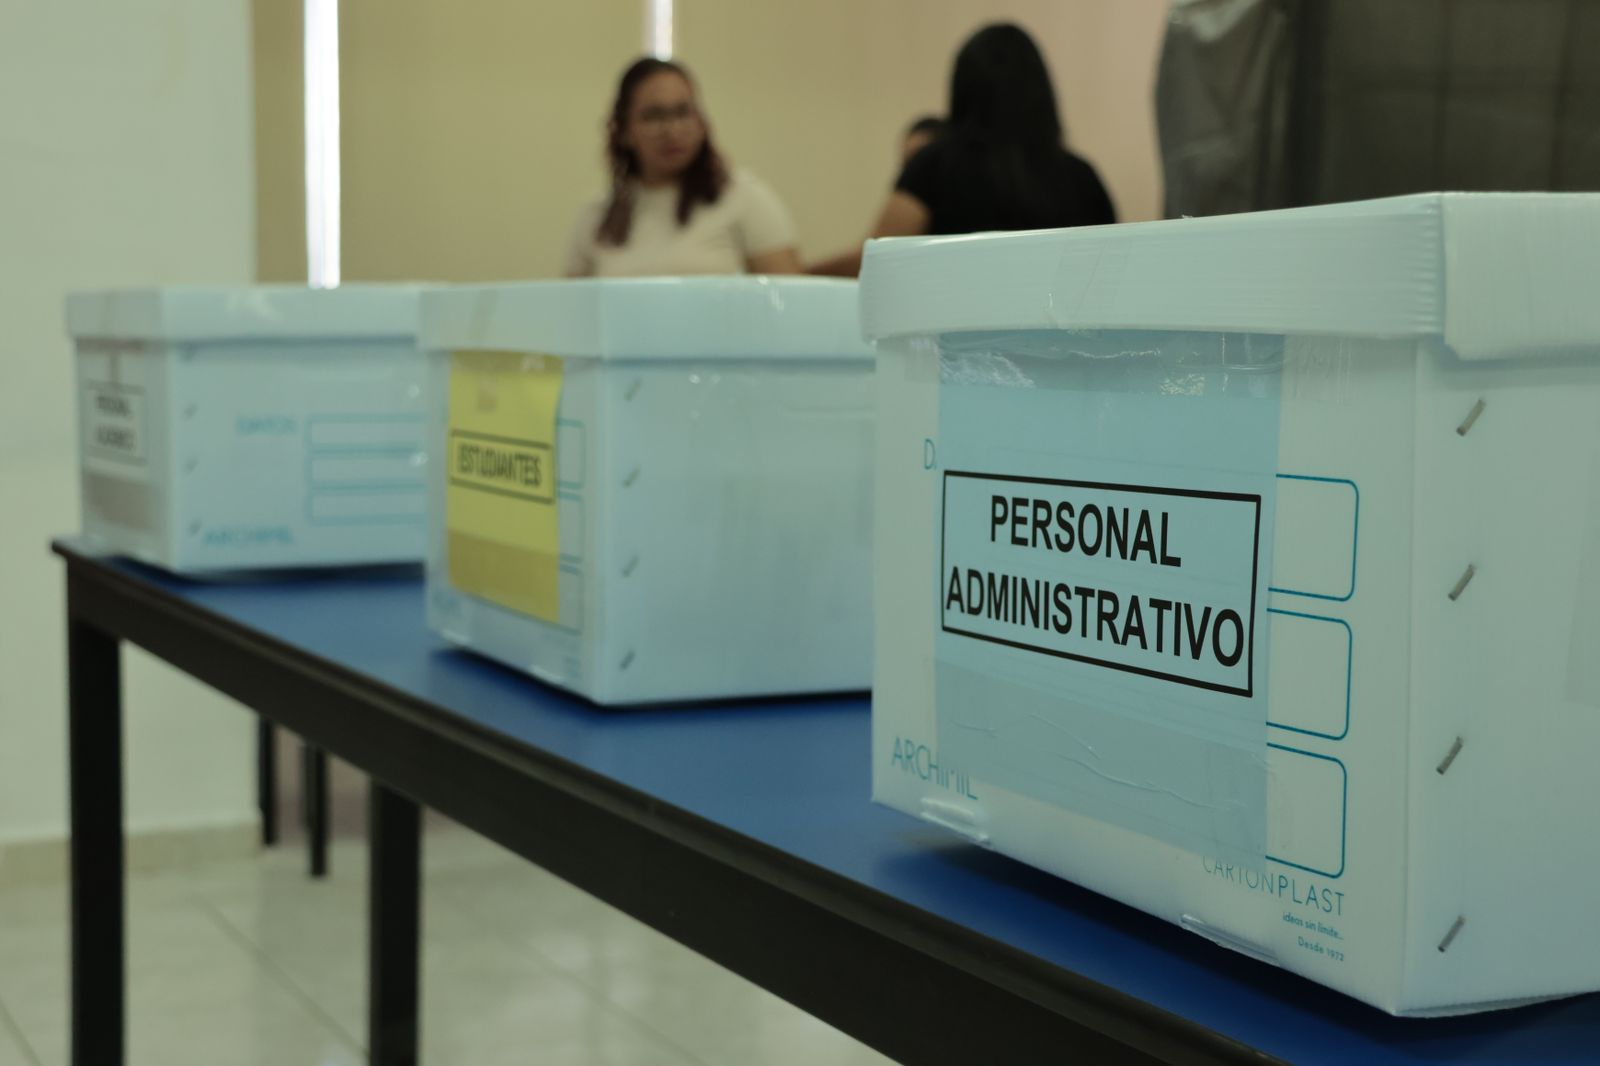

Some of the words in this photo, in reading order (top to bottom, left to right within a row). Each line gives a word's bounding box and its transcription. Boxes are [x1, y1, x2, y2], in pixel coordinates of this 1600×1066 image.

[459, 443, 542, 487] ESTUDIANTES
[990, 494, 1182, 568] PERSONAL
[945, 565, 1245, 668] ADMINISTRATIVO
[1282, 911, 1304, 927] ideas
[1305, 920, 1317, 931] sin
[1297, 935, 1324, 954] Desde
[1327, 947, 1345, 962] 1972
